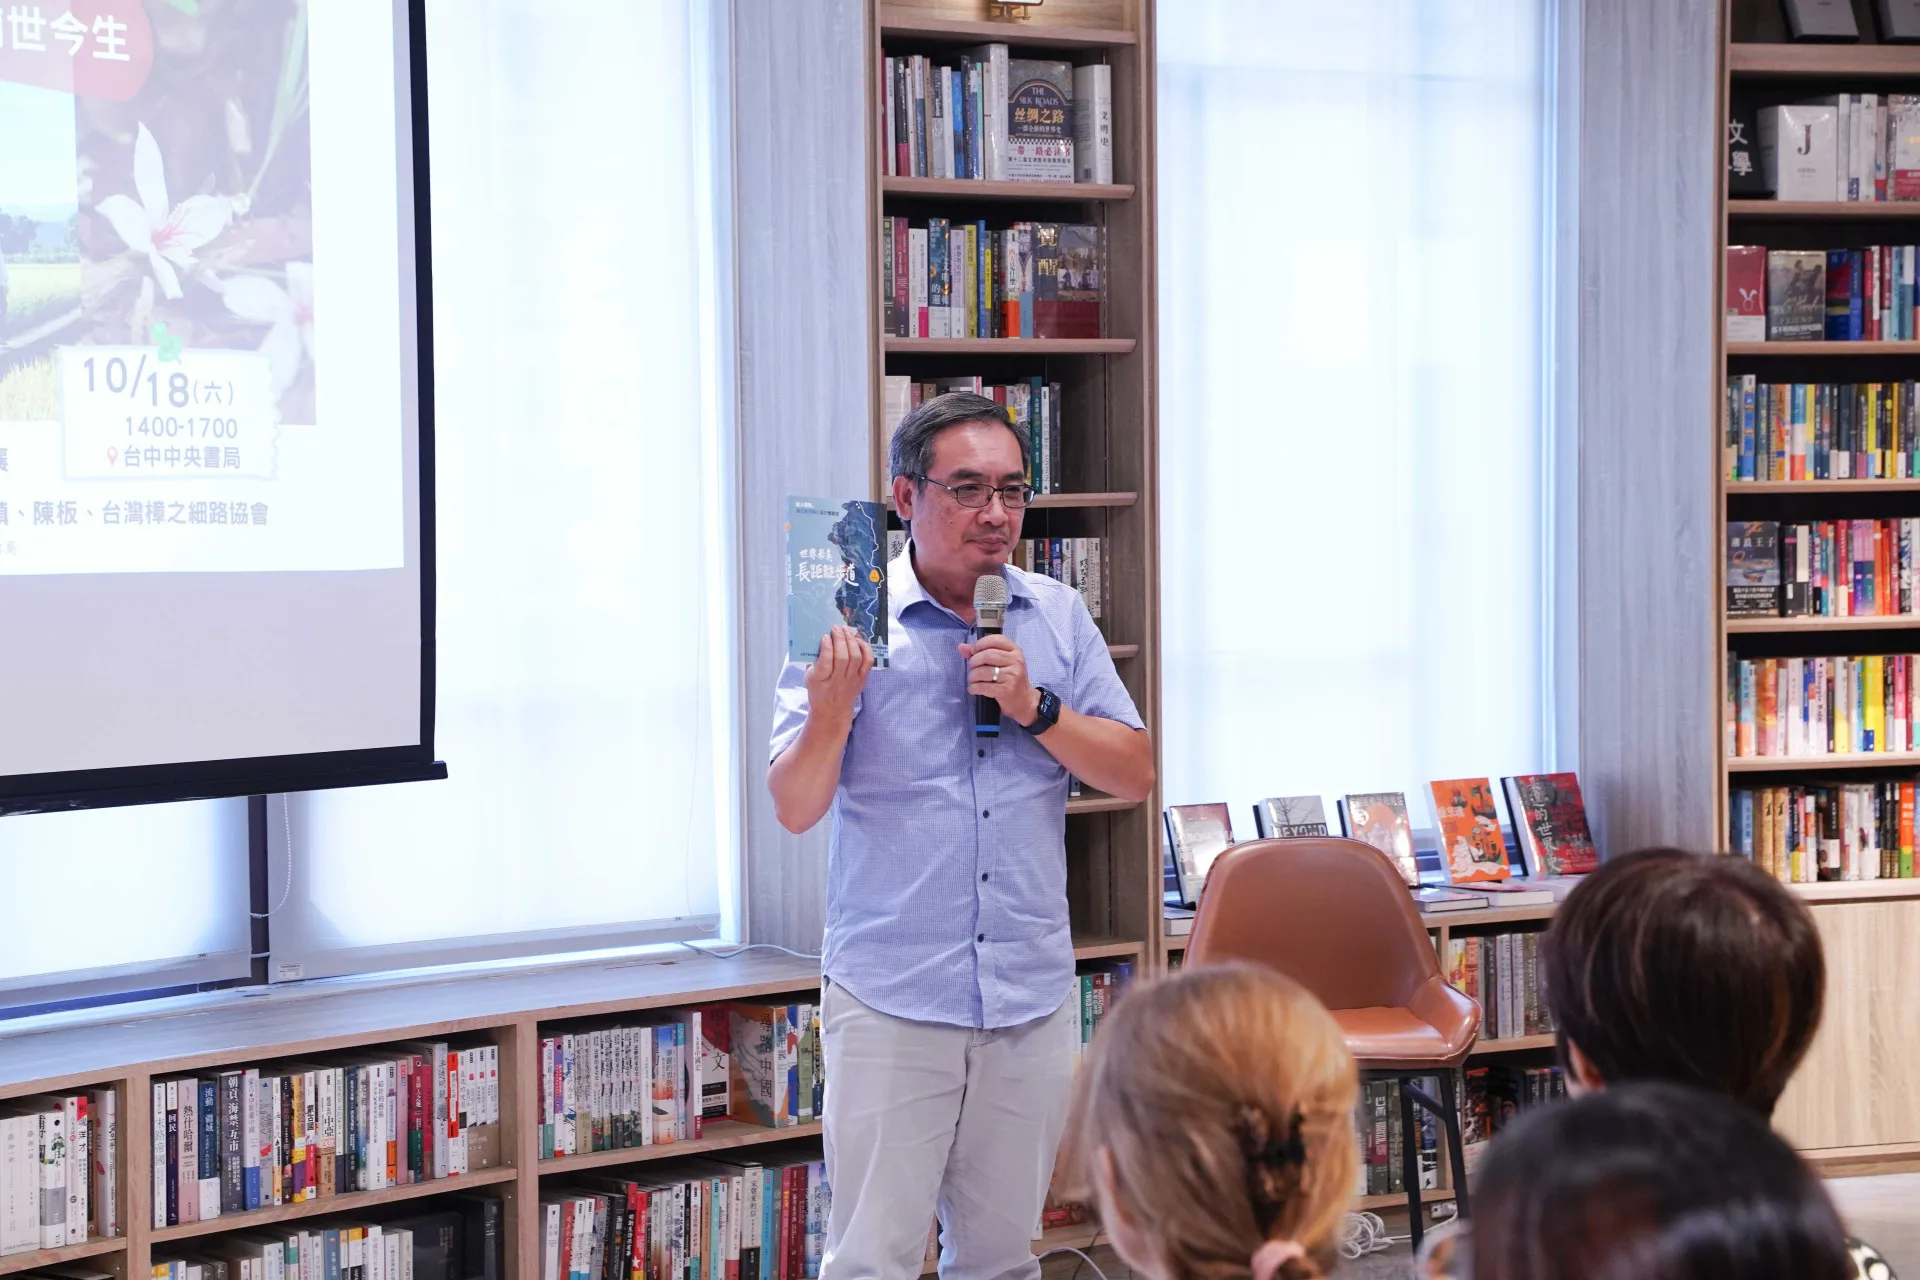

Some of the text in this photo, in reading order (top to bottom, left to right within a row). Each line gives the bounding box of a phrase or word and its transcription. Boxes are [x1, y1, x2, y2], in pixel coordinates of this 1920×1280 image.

[0, 5, 130, 61] 世今生
[1019, 96, 1059, 107] SILK ROADS
[1032, 87, 1045, 96] THE
[1729, 118, 1753, 176] 文學
[125, 415, 239, 439] 1400-1700
[123, 445, 241, 470] 台中中央書局
